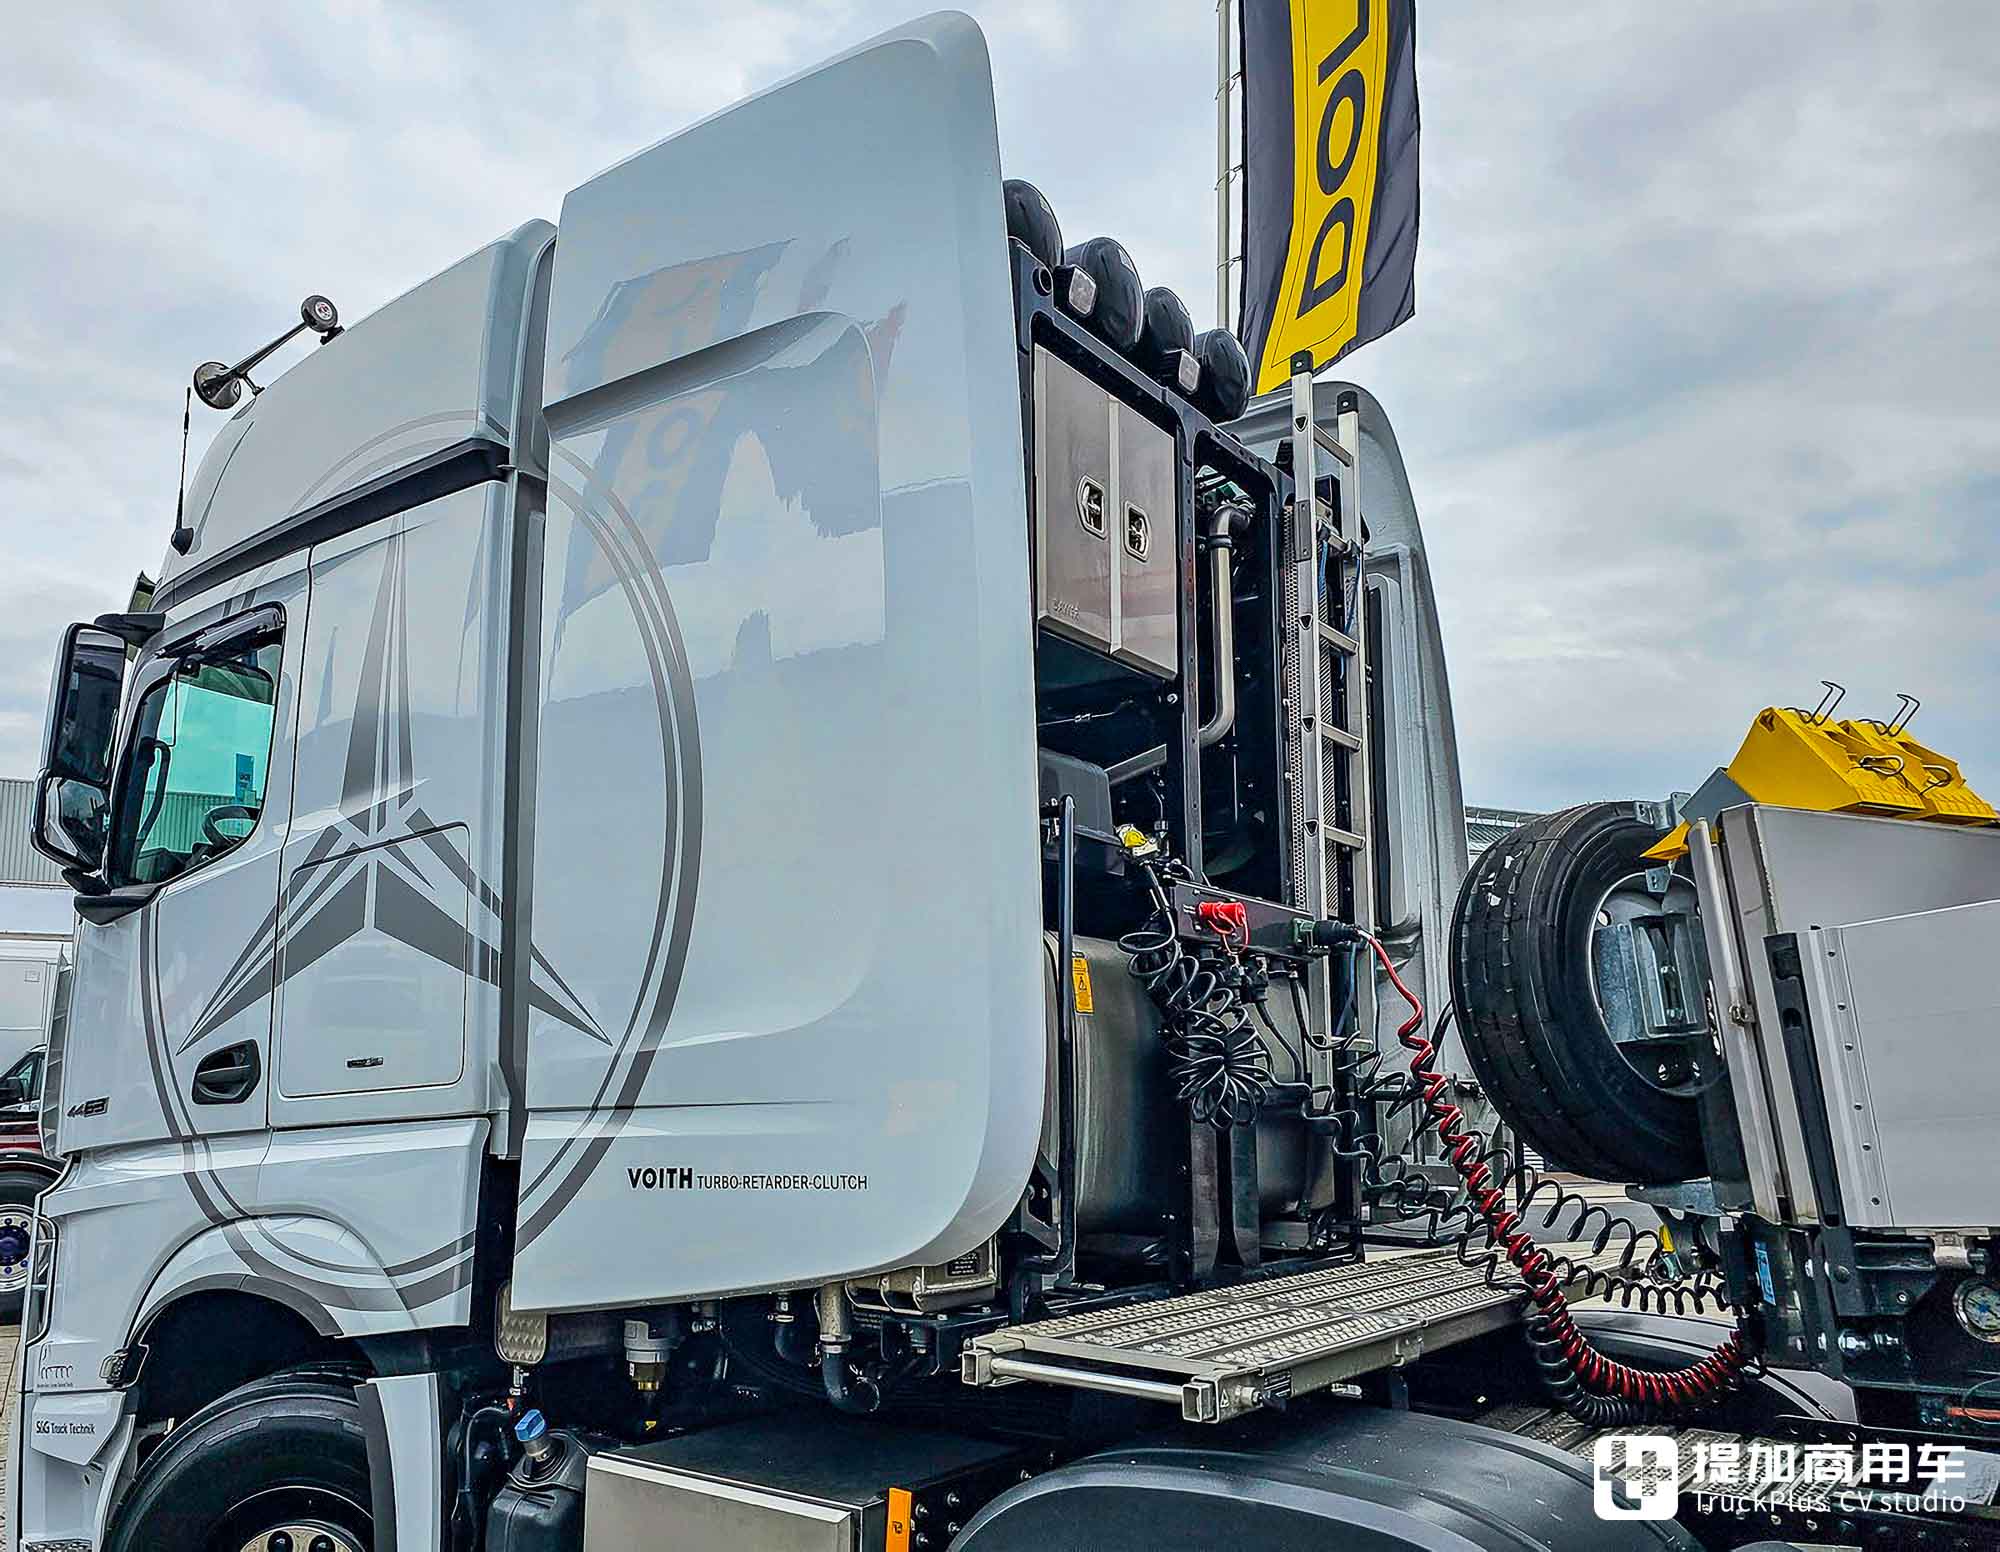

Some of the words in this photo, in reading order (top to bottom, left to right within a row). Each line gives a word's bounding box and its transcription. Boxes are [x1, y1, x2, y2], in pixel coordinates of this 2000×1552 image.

[627, 1167, 693, 1189] VOITH
[697, 1174, 868, 1190] TURBO-RETARDER-CLUTCH
[51, 1422, 68, 1434] Truck
[69, 1422, 96, 1434] Technik
